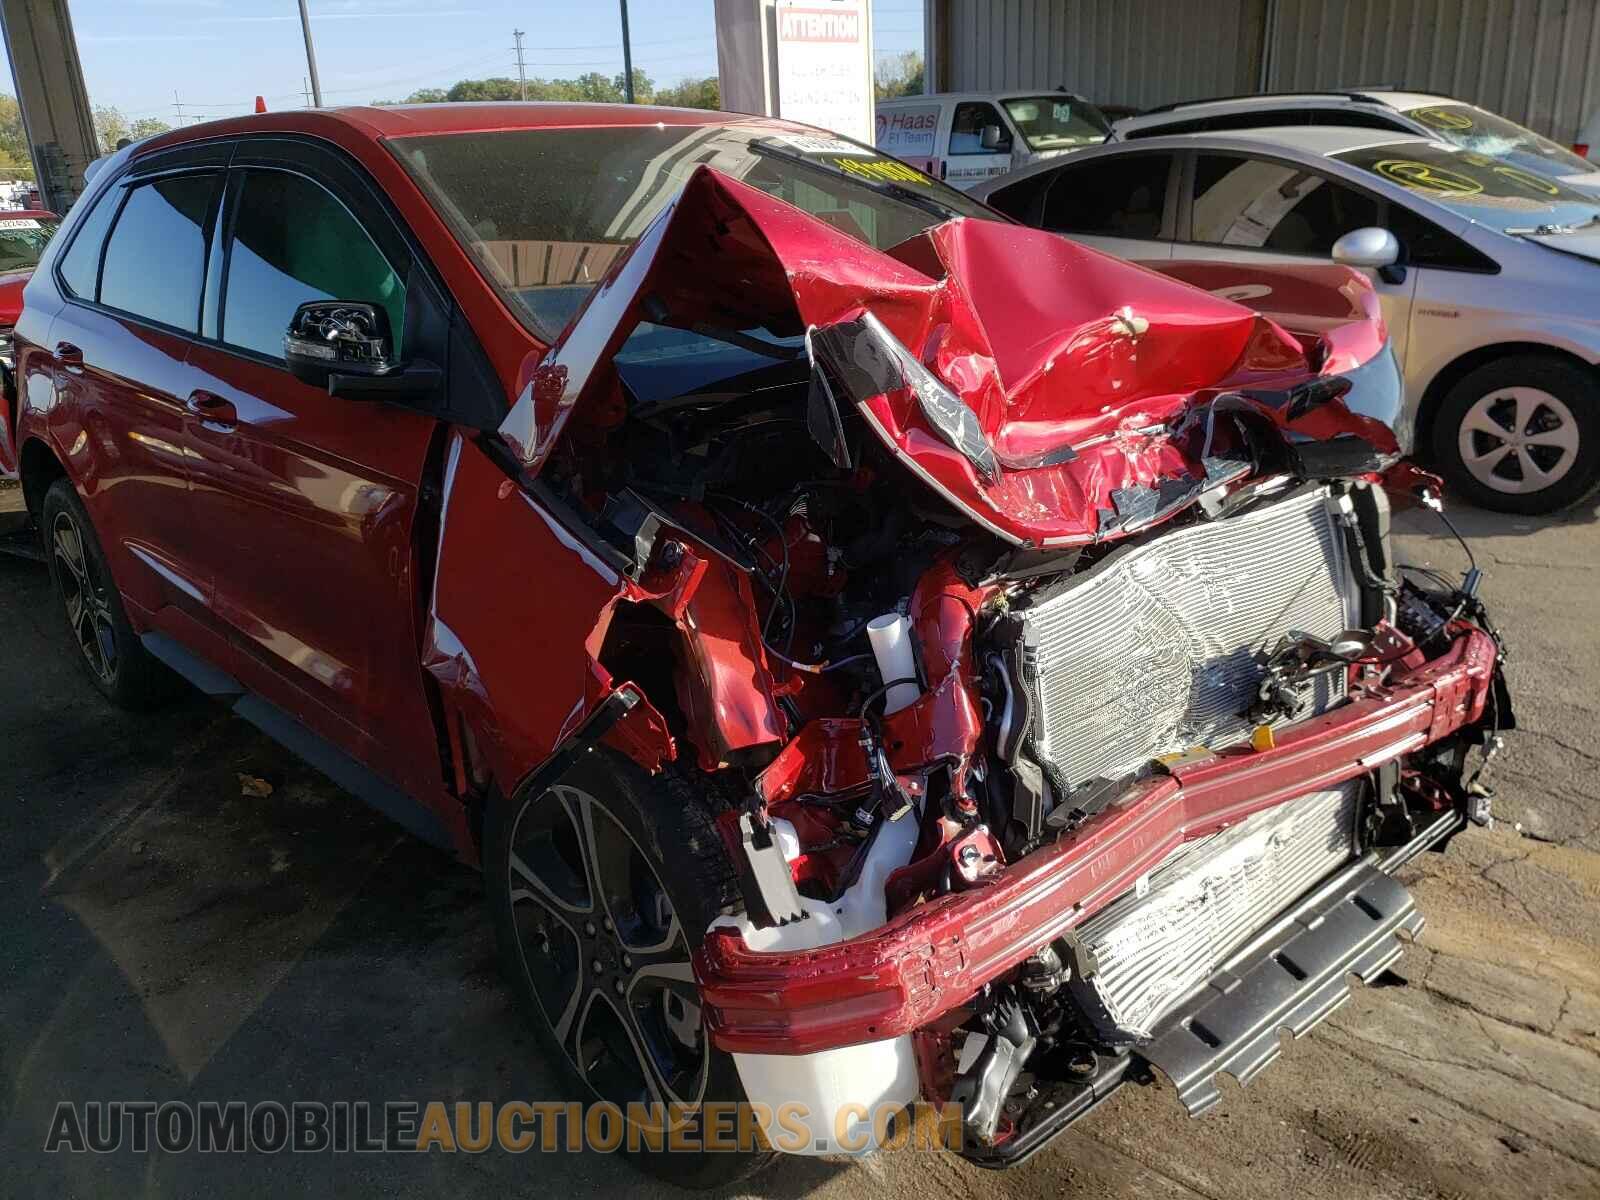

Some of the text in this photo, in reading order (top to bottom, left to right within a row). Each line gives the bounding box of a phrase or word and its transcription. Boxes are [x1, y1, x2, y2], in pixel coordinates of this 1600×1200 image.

[781, 12, 857, 39] ATTENTION
[890, 113, 936, 129] Haas
[903, 131, 933, 144] Team
